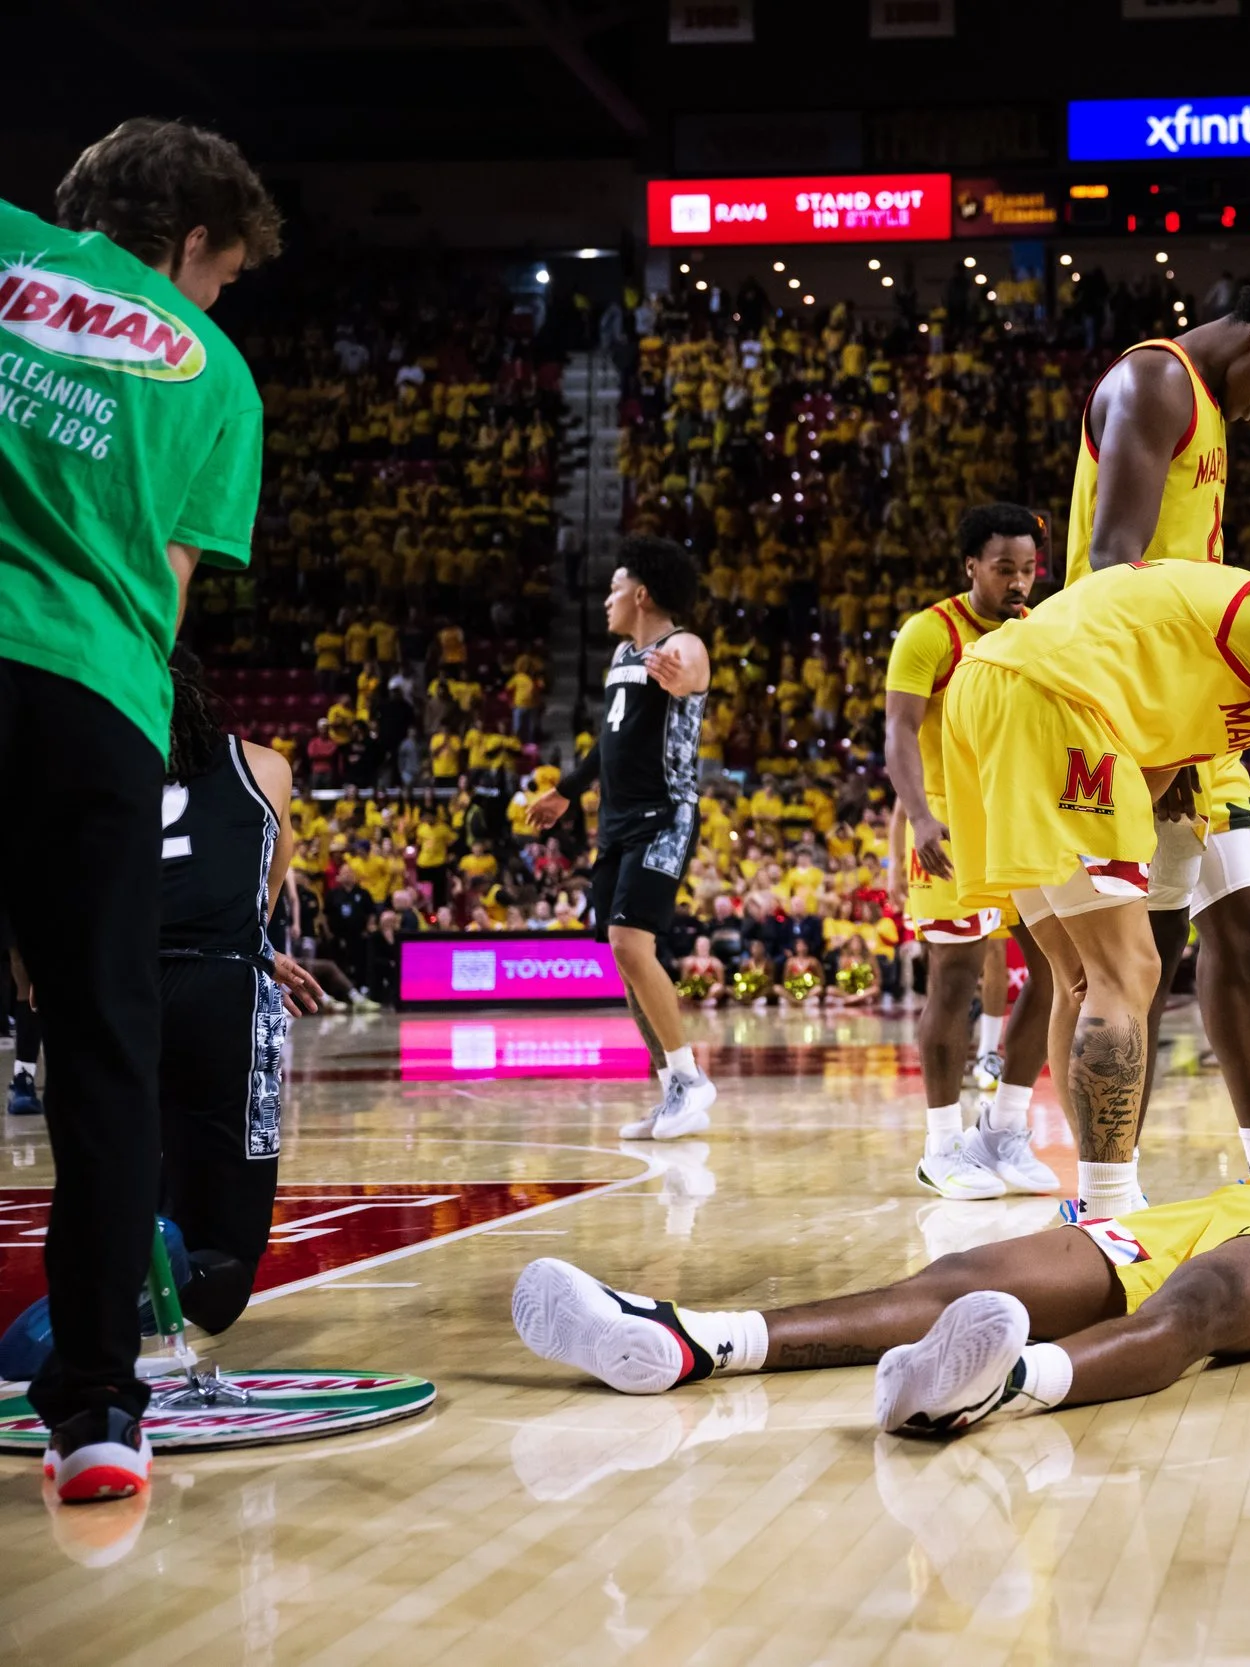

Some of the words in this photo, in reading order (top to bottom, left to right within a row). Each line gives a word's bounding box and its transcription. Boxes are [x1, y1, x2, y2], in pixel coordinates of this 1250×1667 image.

[715, 203, 767, 222] RAV4
[796, 192, 870, 211] STAND
[875, 190, 923, 210] OUT
[813, 211, 839, 228] IN
[845, 209, 910, 228] STYLE
[0, 276, 193, 366] IBMAN
[0, 352, 117, 424] CLEANING
[0, 384, 42, 429] NCE
[48, 412, 112, 460] 1896
[607, 687, 626, 732] 4
[1060, 747, 1117, 807] M
[502, 958, 603, 979] TOYOTA
